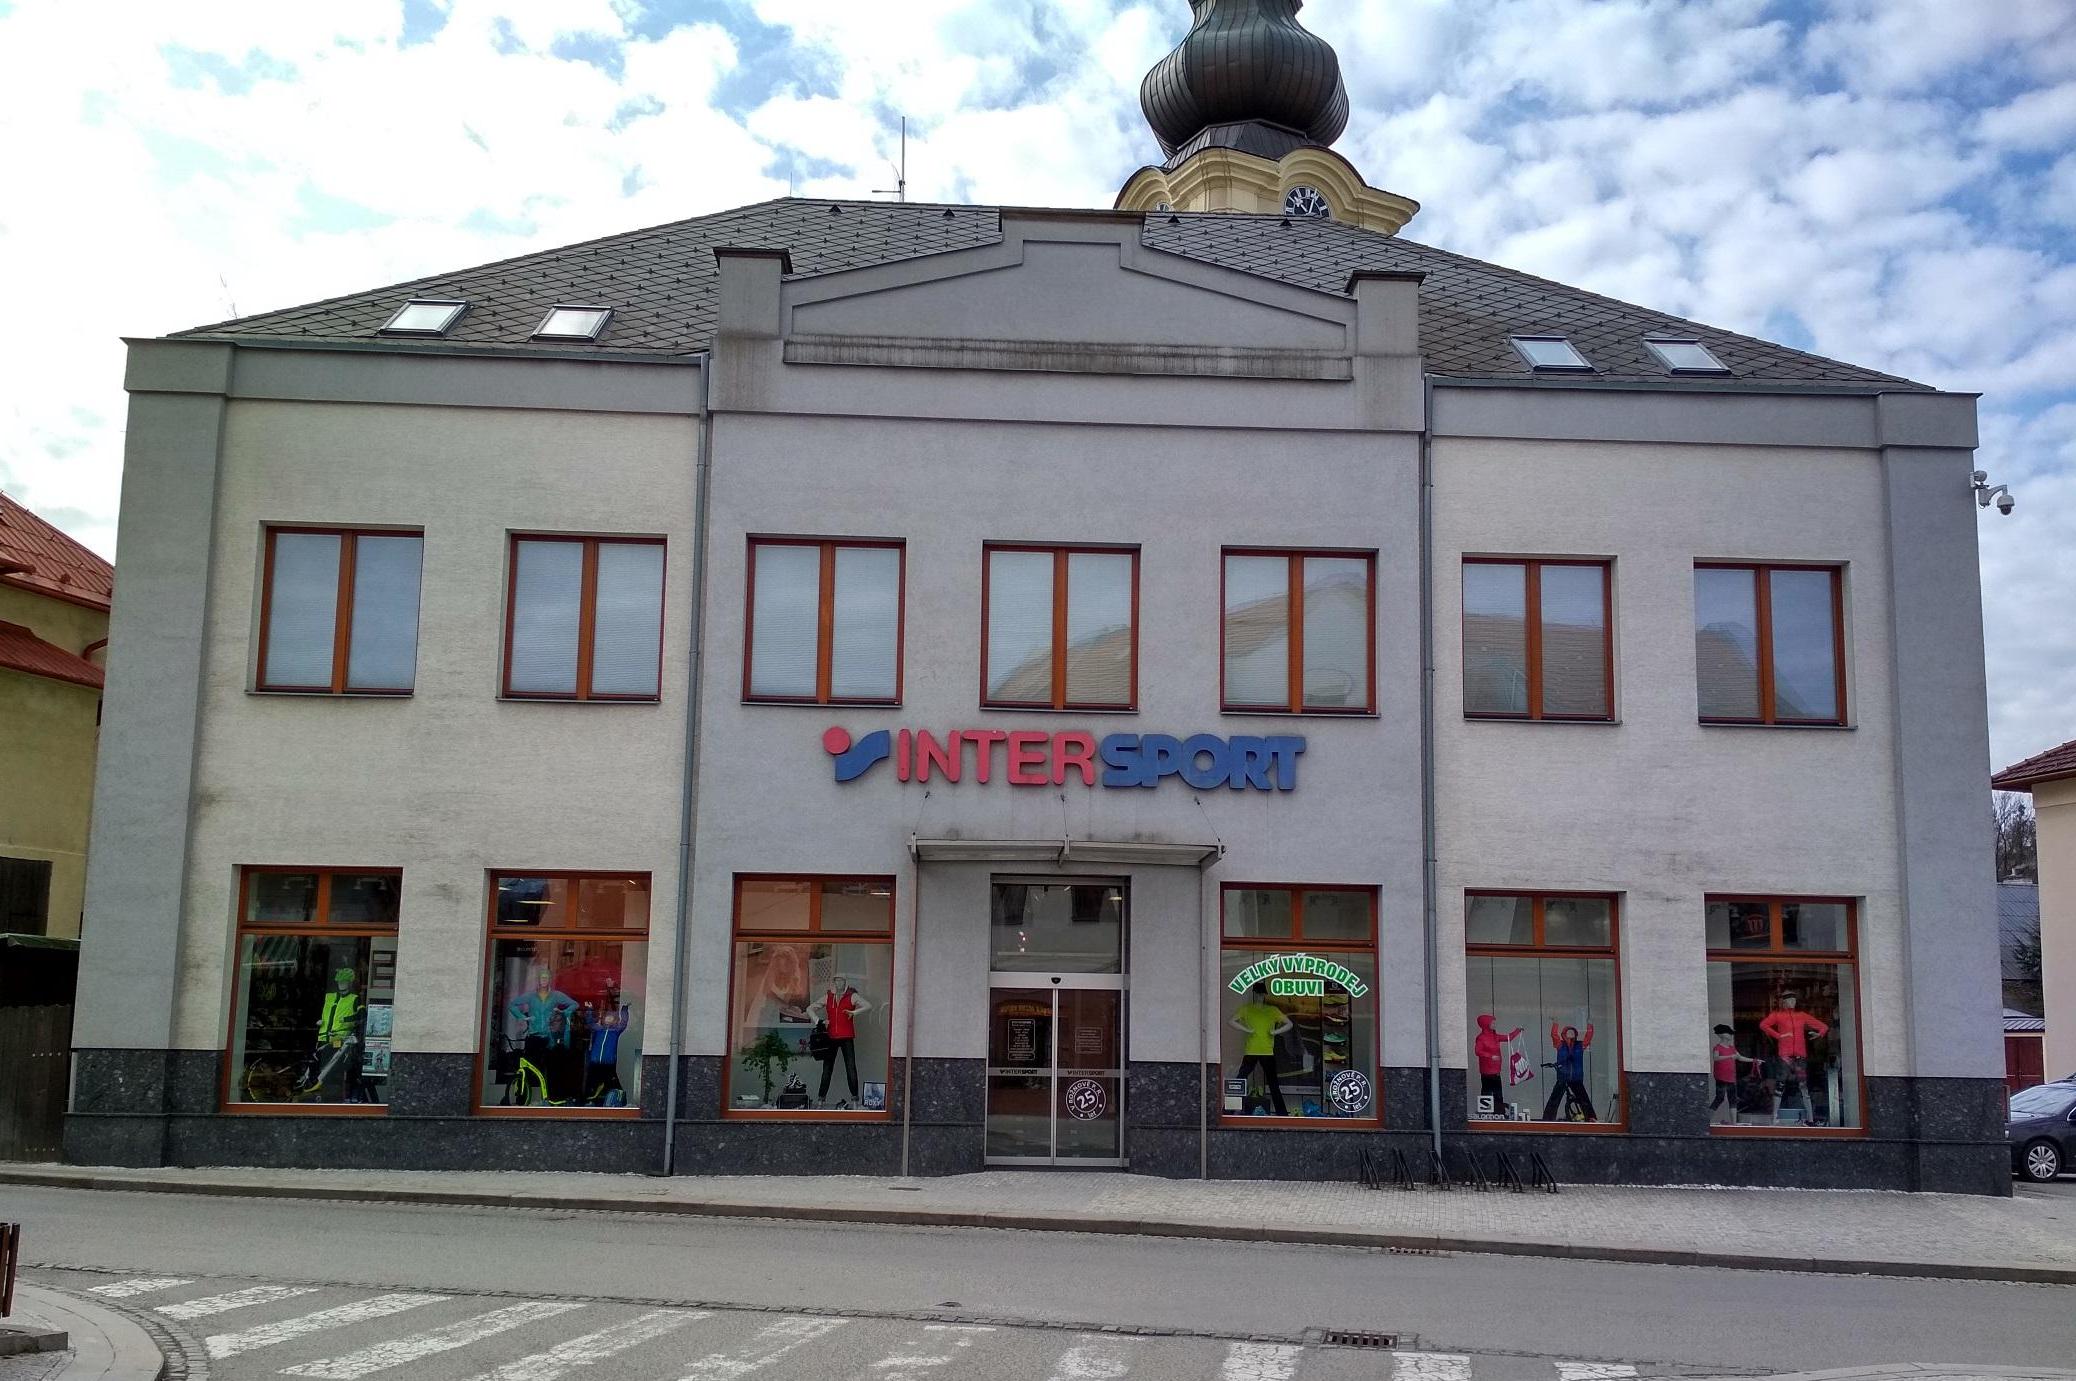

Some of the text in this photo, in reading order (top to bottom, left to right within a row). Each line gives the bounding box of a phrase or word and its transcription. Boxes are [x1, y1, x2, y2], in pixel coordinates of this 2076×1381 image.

[898, 728, 1305, 790] INTERSPORT
[1228, 953, 1368, 998] VELKÝ VÝPRODEJ
[1271, 978, 1324, 997] OBUVI
[1077, 1090, 1095, 1109] 25
[1340, 1081, 1360, 1100] 25
